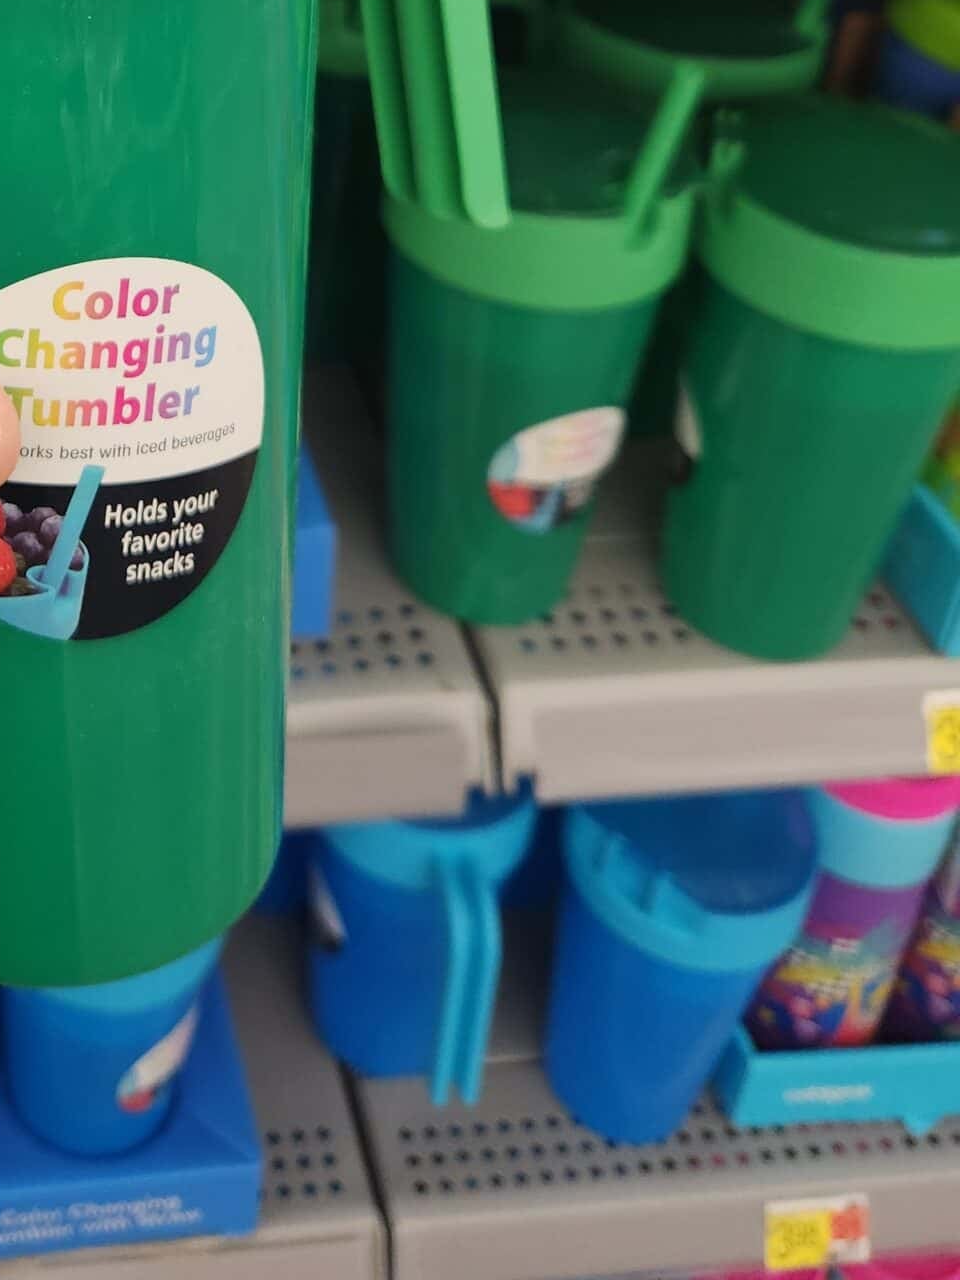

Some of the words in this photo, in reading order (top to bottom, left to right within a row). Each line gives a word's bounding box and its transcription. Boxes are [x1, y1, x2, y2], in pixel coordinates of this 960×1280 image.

[51, 277, 180, 321] Color
[4, 382, 201, 428] Tumbler
[19, 445, 54, 460] orks
[59, 445, 95, 460] best
[99, 442, 132, 459] with
[136, 438, 168, 456] iced
[171, 422, 237, 451] beverages
[103, 497, 169, 529] Holds
[172, 488, 220, 522] your
[121, 521, 205, 557] favorite
[125, 549, 196, 585] snacks
